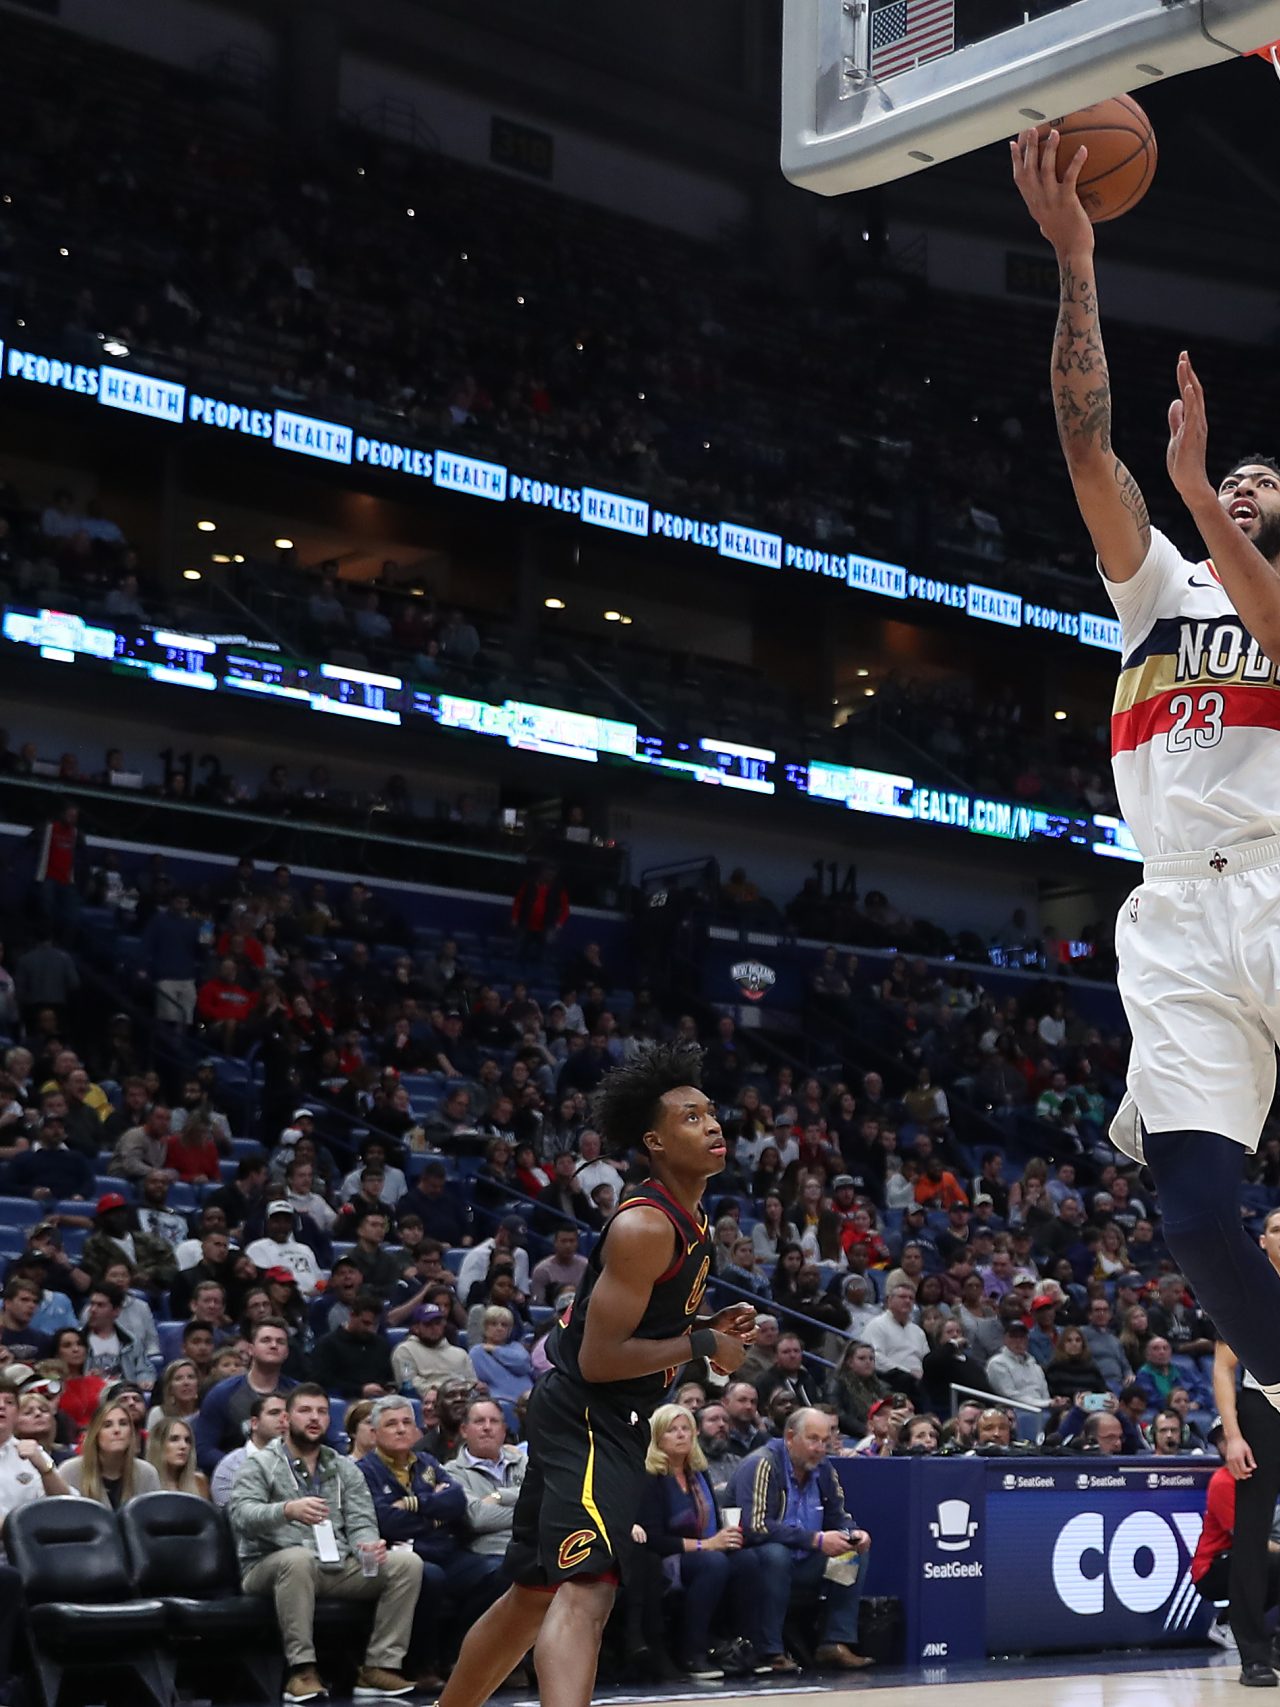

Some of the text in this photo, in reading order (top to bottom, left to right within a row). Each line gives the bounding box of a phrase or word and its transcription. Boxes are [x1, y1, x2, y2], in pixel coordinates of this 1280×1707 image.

[8, 349, 1122, 646] PEOPLES HEALTH PEOPLES HEALTH PEOPLES HEALTH PEOPLES HEALTH PEOPLES HEALTH PEOPLES HEALTH PEOPLES HEALTH PEOPLES HEALT
[1166, 691, 1226, 753] 23
[1018, 1476, 1055, 1488] SeatGeek
[1091, 1475, 1126, 1487] SeatGeek
[1160, 1475, 1194, 1487] SeatGeek
[558, 1529, 597, 1569] C
[924, 1561, 983, 1579] SeatGeek
[922, 1642, 947, 1657] ANC
